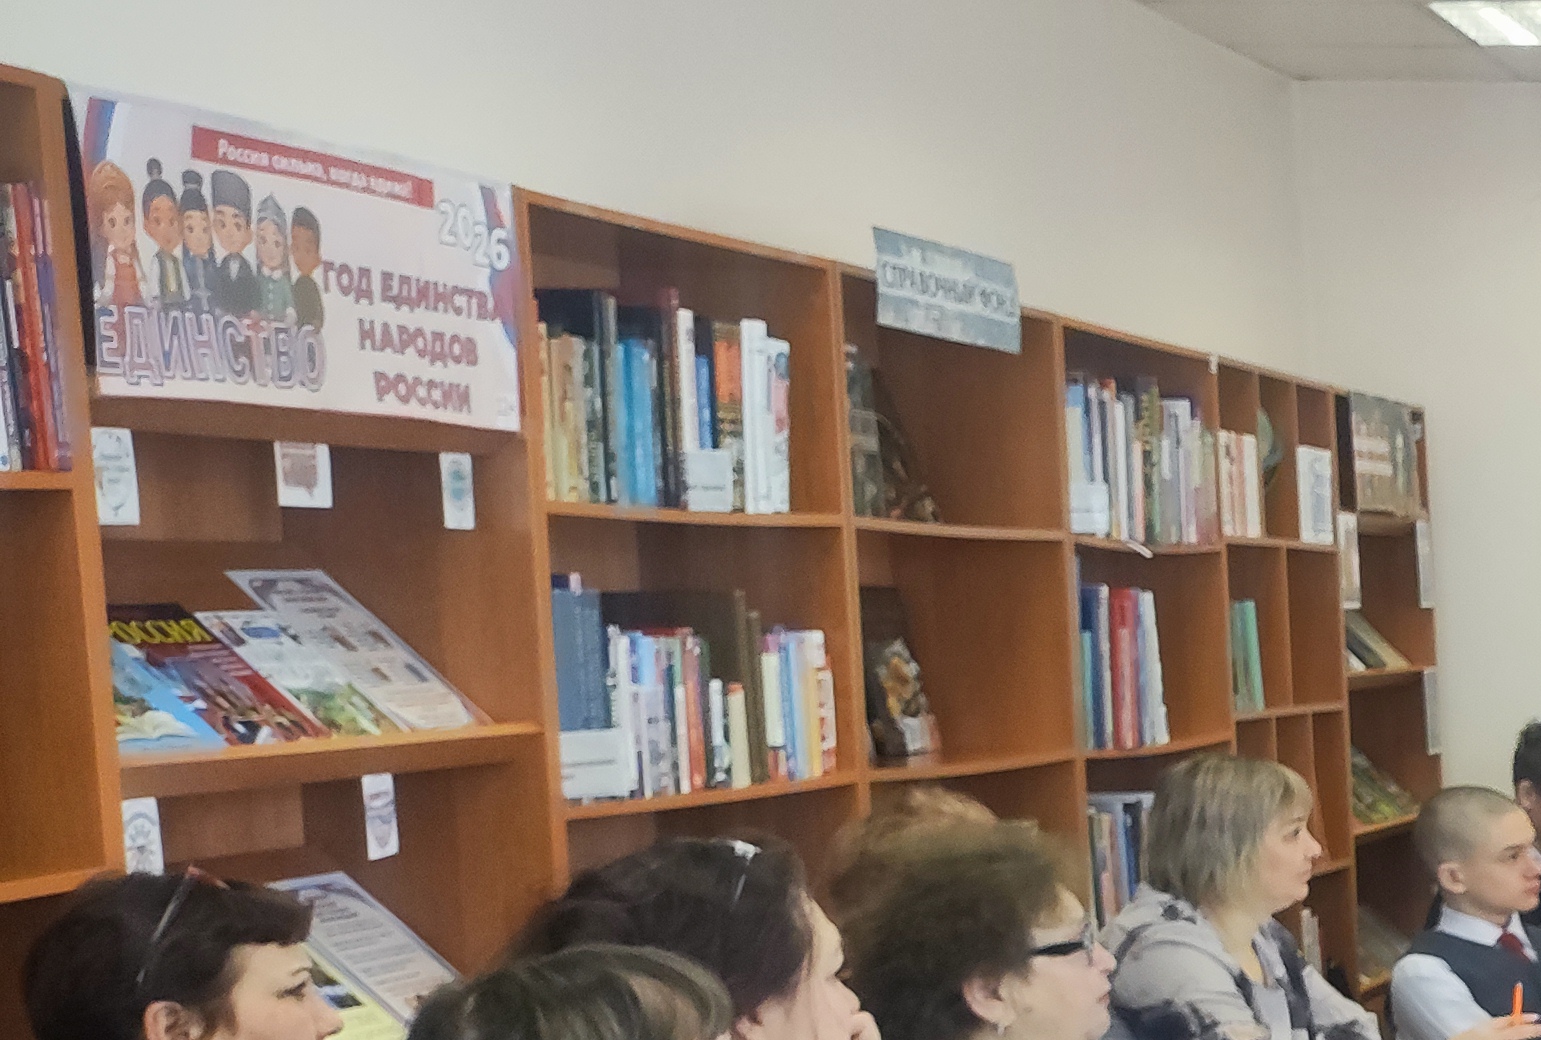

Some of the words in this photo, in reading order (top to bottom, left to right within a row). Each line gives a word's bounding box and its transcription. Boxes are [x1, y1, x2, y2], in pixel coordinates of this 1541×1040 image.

[436, 199, 511, 271] 2026
[322, 260, 375, 306] ГОД
[380, 269, 504, 321] ЕДИНСТВА
[96, 303, 326, 393] ЕДИНСТВО
[358, 318, 478, 368] НАРОДОВ
[373, 371, 472, 413] РОССИИ
[109, 619, 214, 645] ОССИЯ
